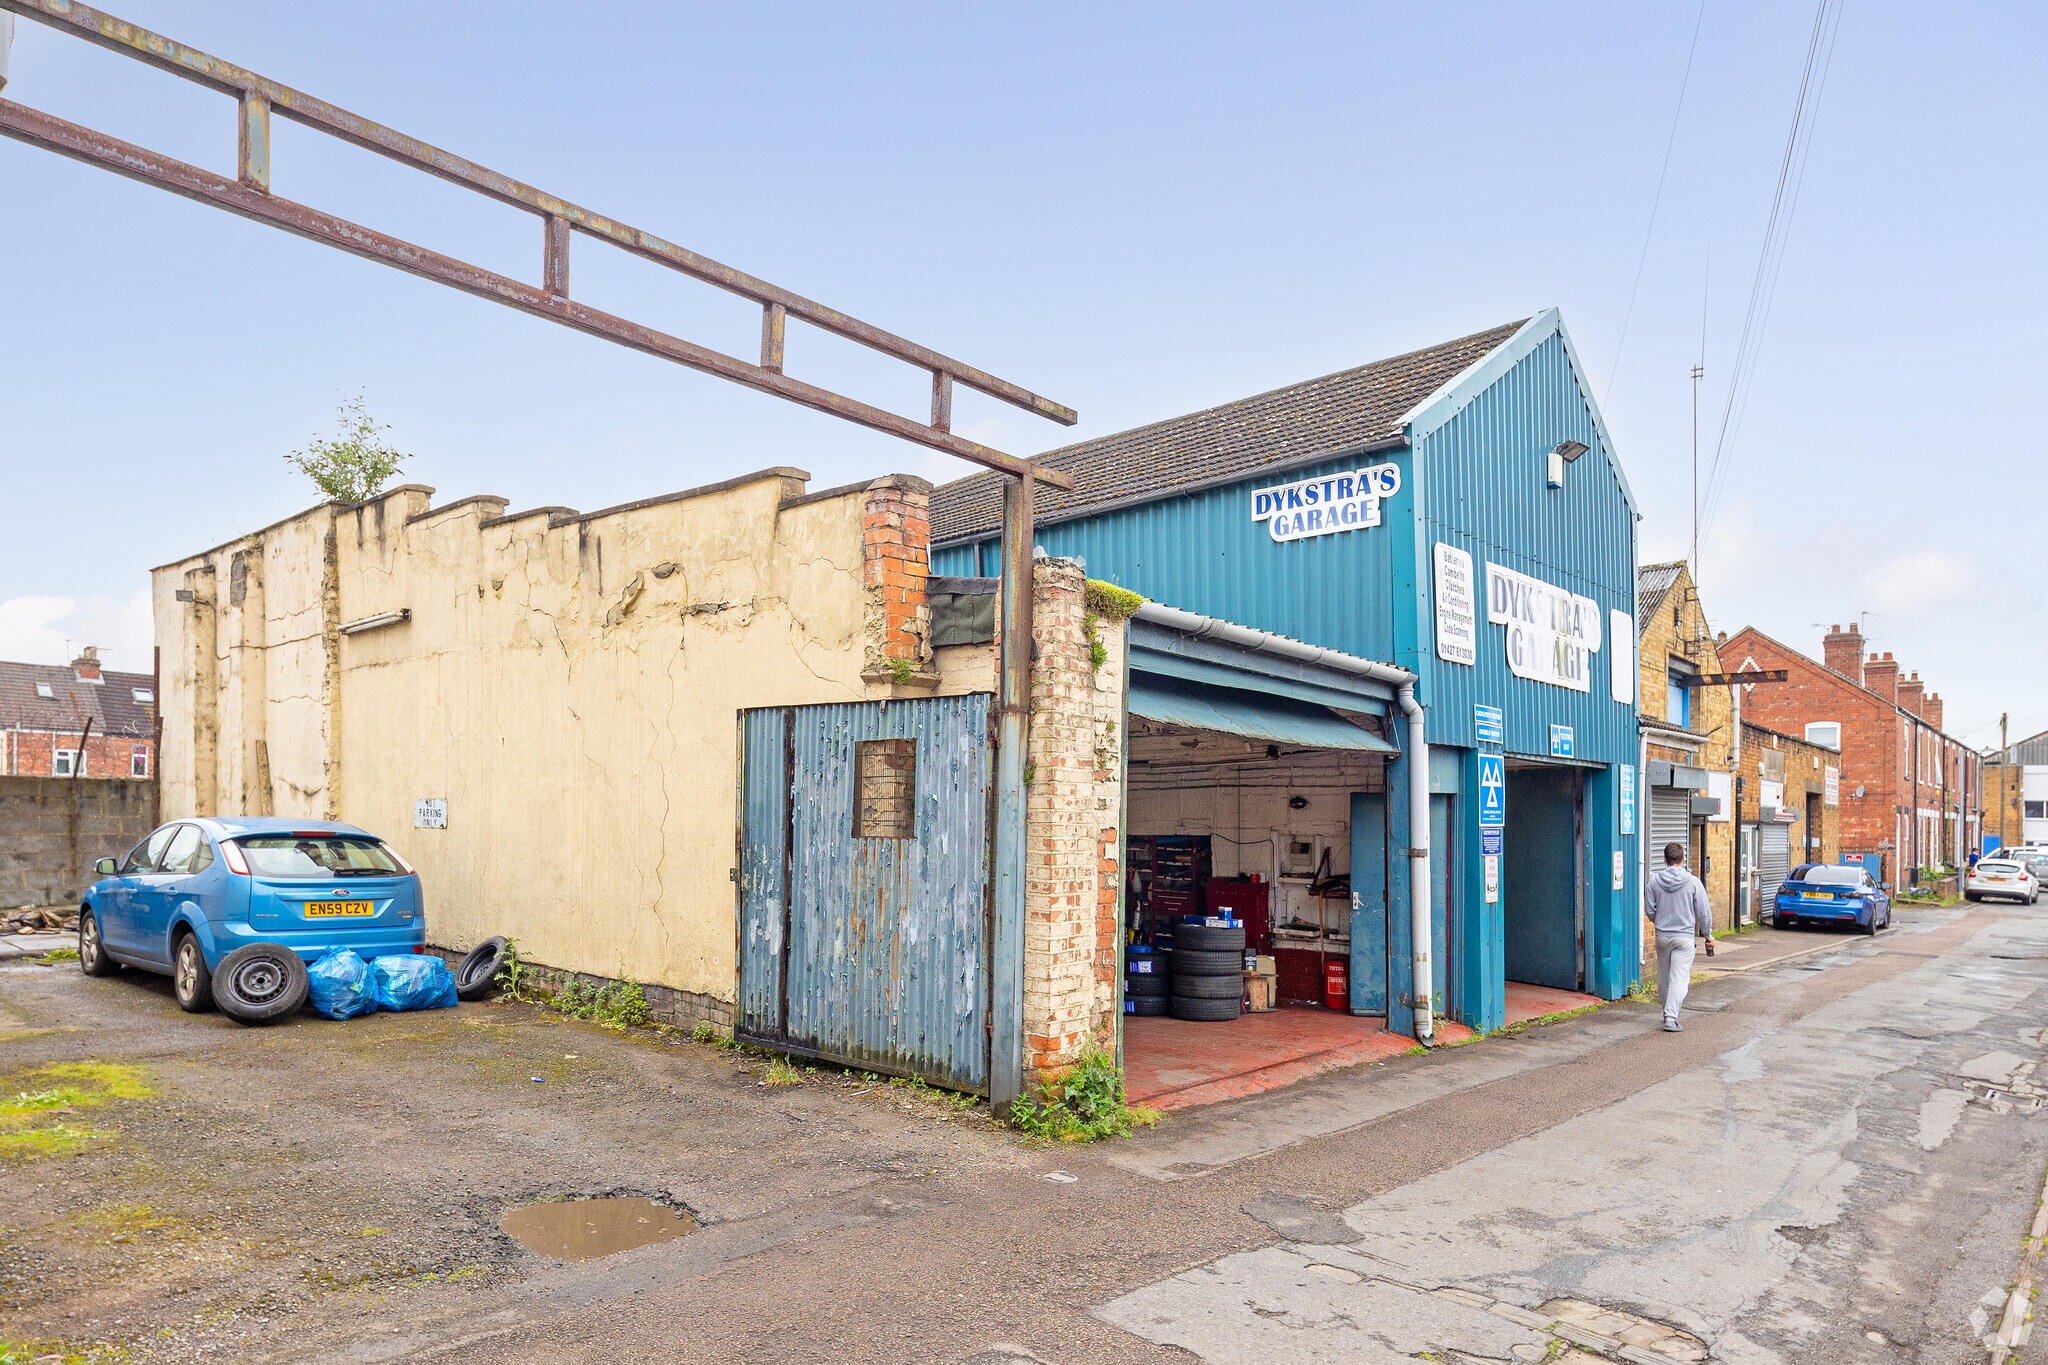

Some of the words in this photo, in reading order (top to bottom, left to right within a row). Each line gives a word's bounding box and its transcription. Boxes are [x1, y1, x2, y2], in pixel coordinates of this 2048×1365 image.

[1255, 468, 1396, 515] DYKSTRA'S
[1274, 499, 1375, 537] GARAGE
[1446, 578, 1465, 596] Clutches
[419, 808, 442, 818] PARKING
[310, 903, 342, 915] EN59
[346, 903, 368, 914] CZV
